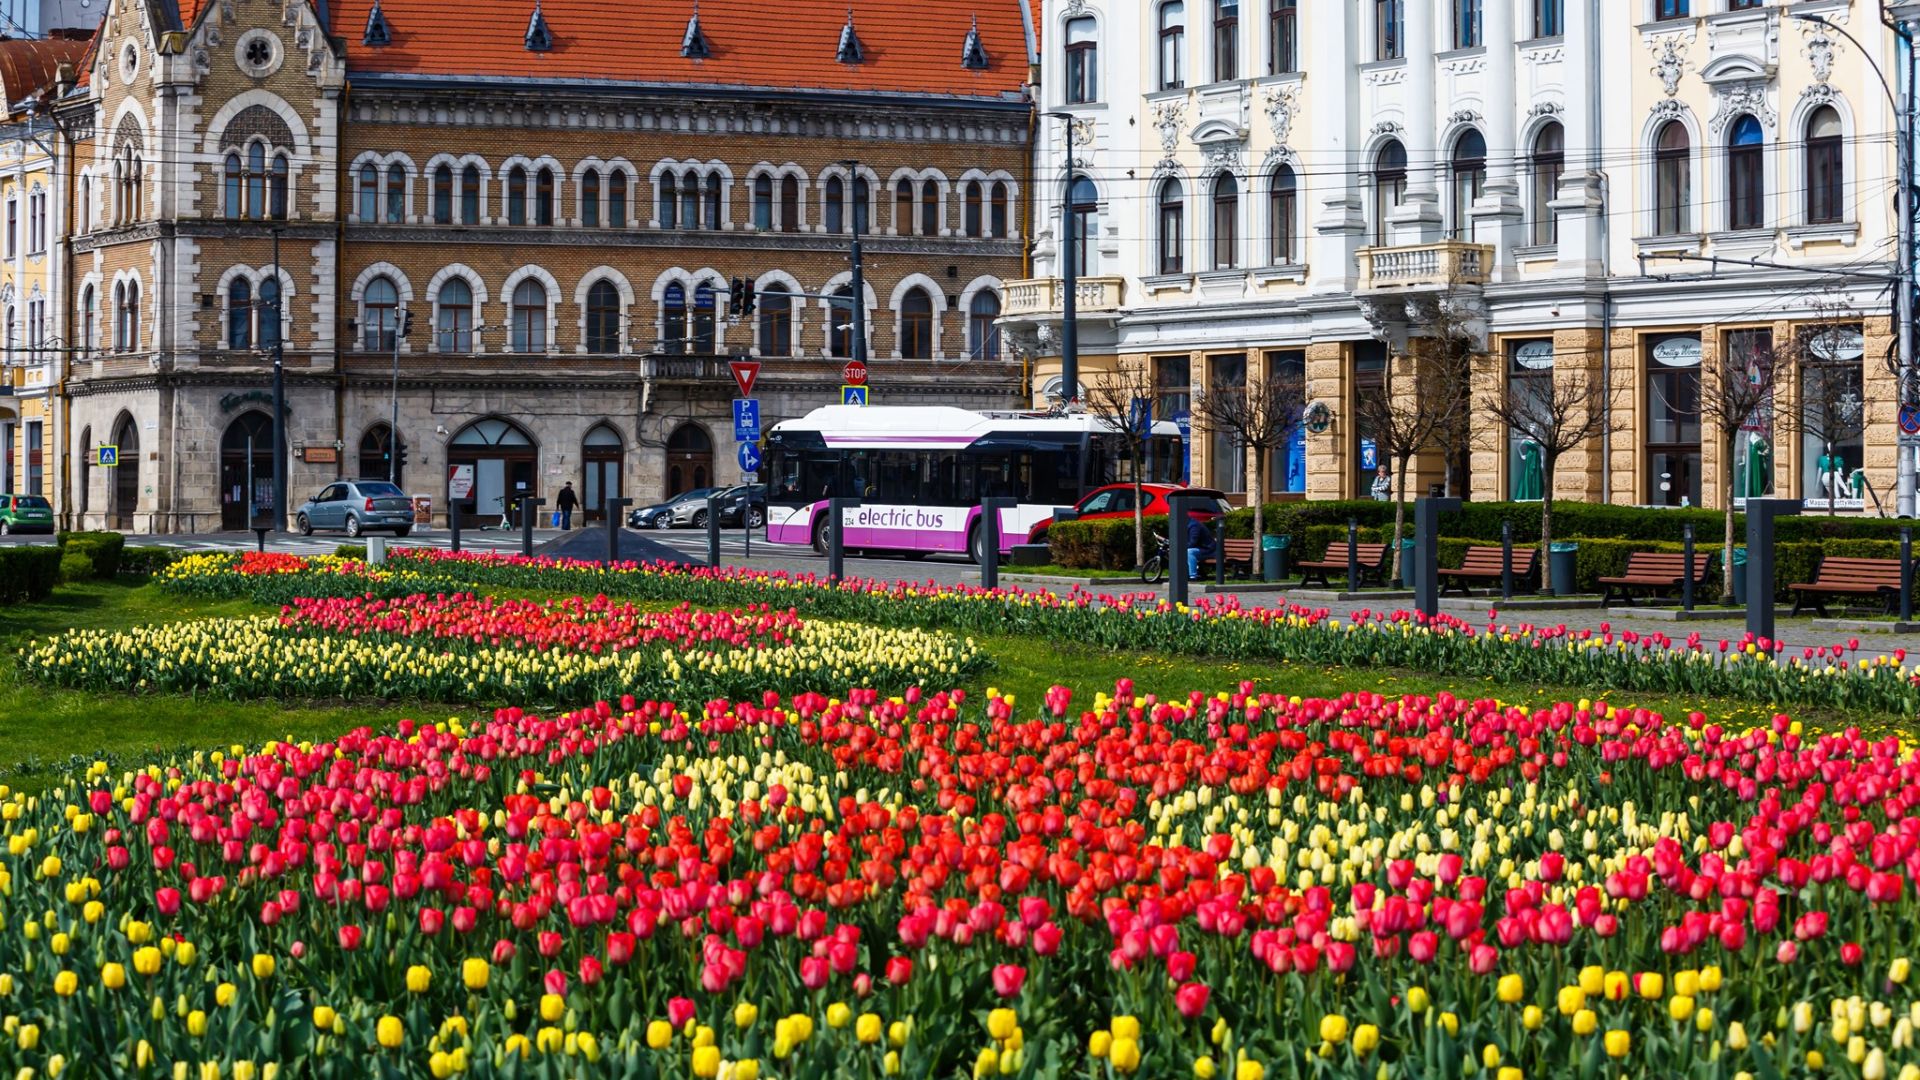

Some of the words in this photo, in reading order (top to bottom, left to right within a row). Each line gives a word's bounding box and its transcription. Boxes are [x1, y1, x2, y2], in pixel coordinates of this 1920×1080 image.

[1681, 344, 1702, 355] Wome
[845, 368, 867, 379] STOP
[742, 400, 750, 412] P
[844, 517, 854, 526] 234
[858, 508, 913, 526] electric
[916, 509, 943, 528] bus
